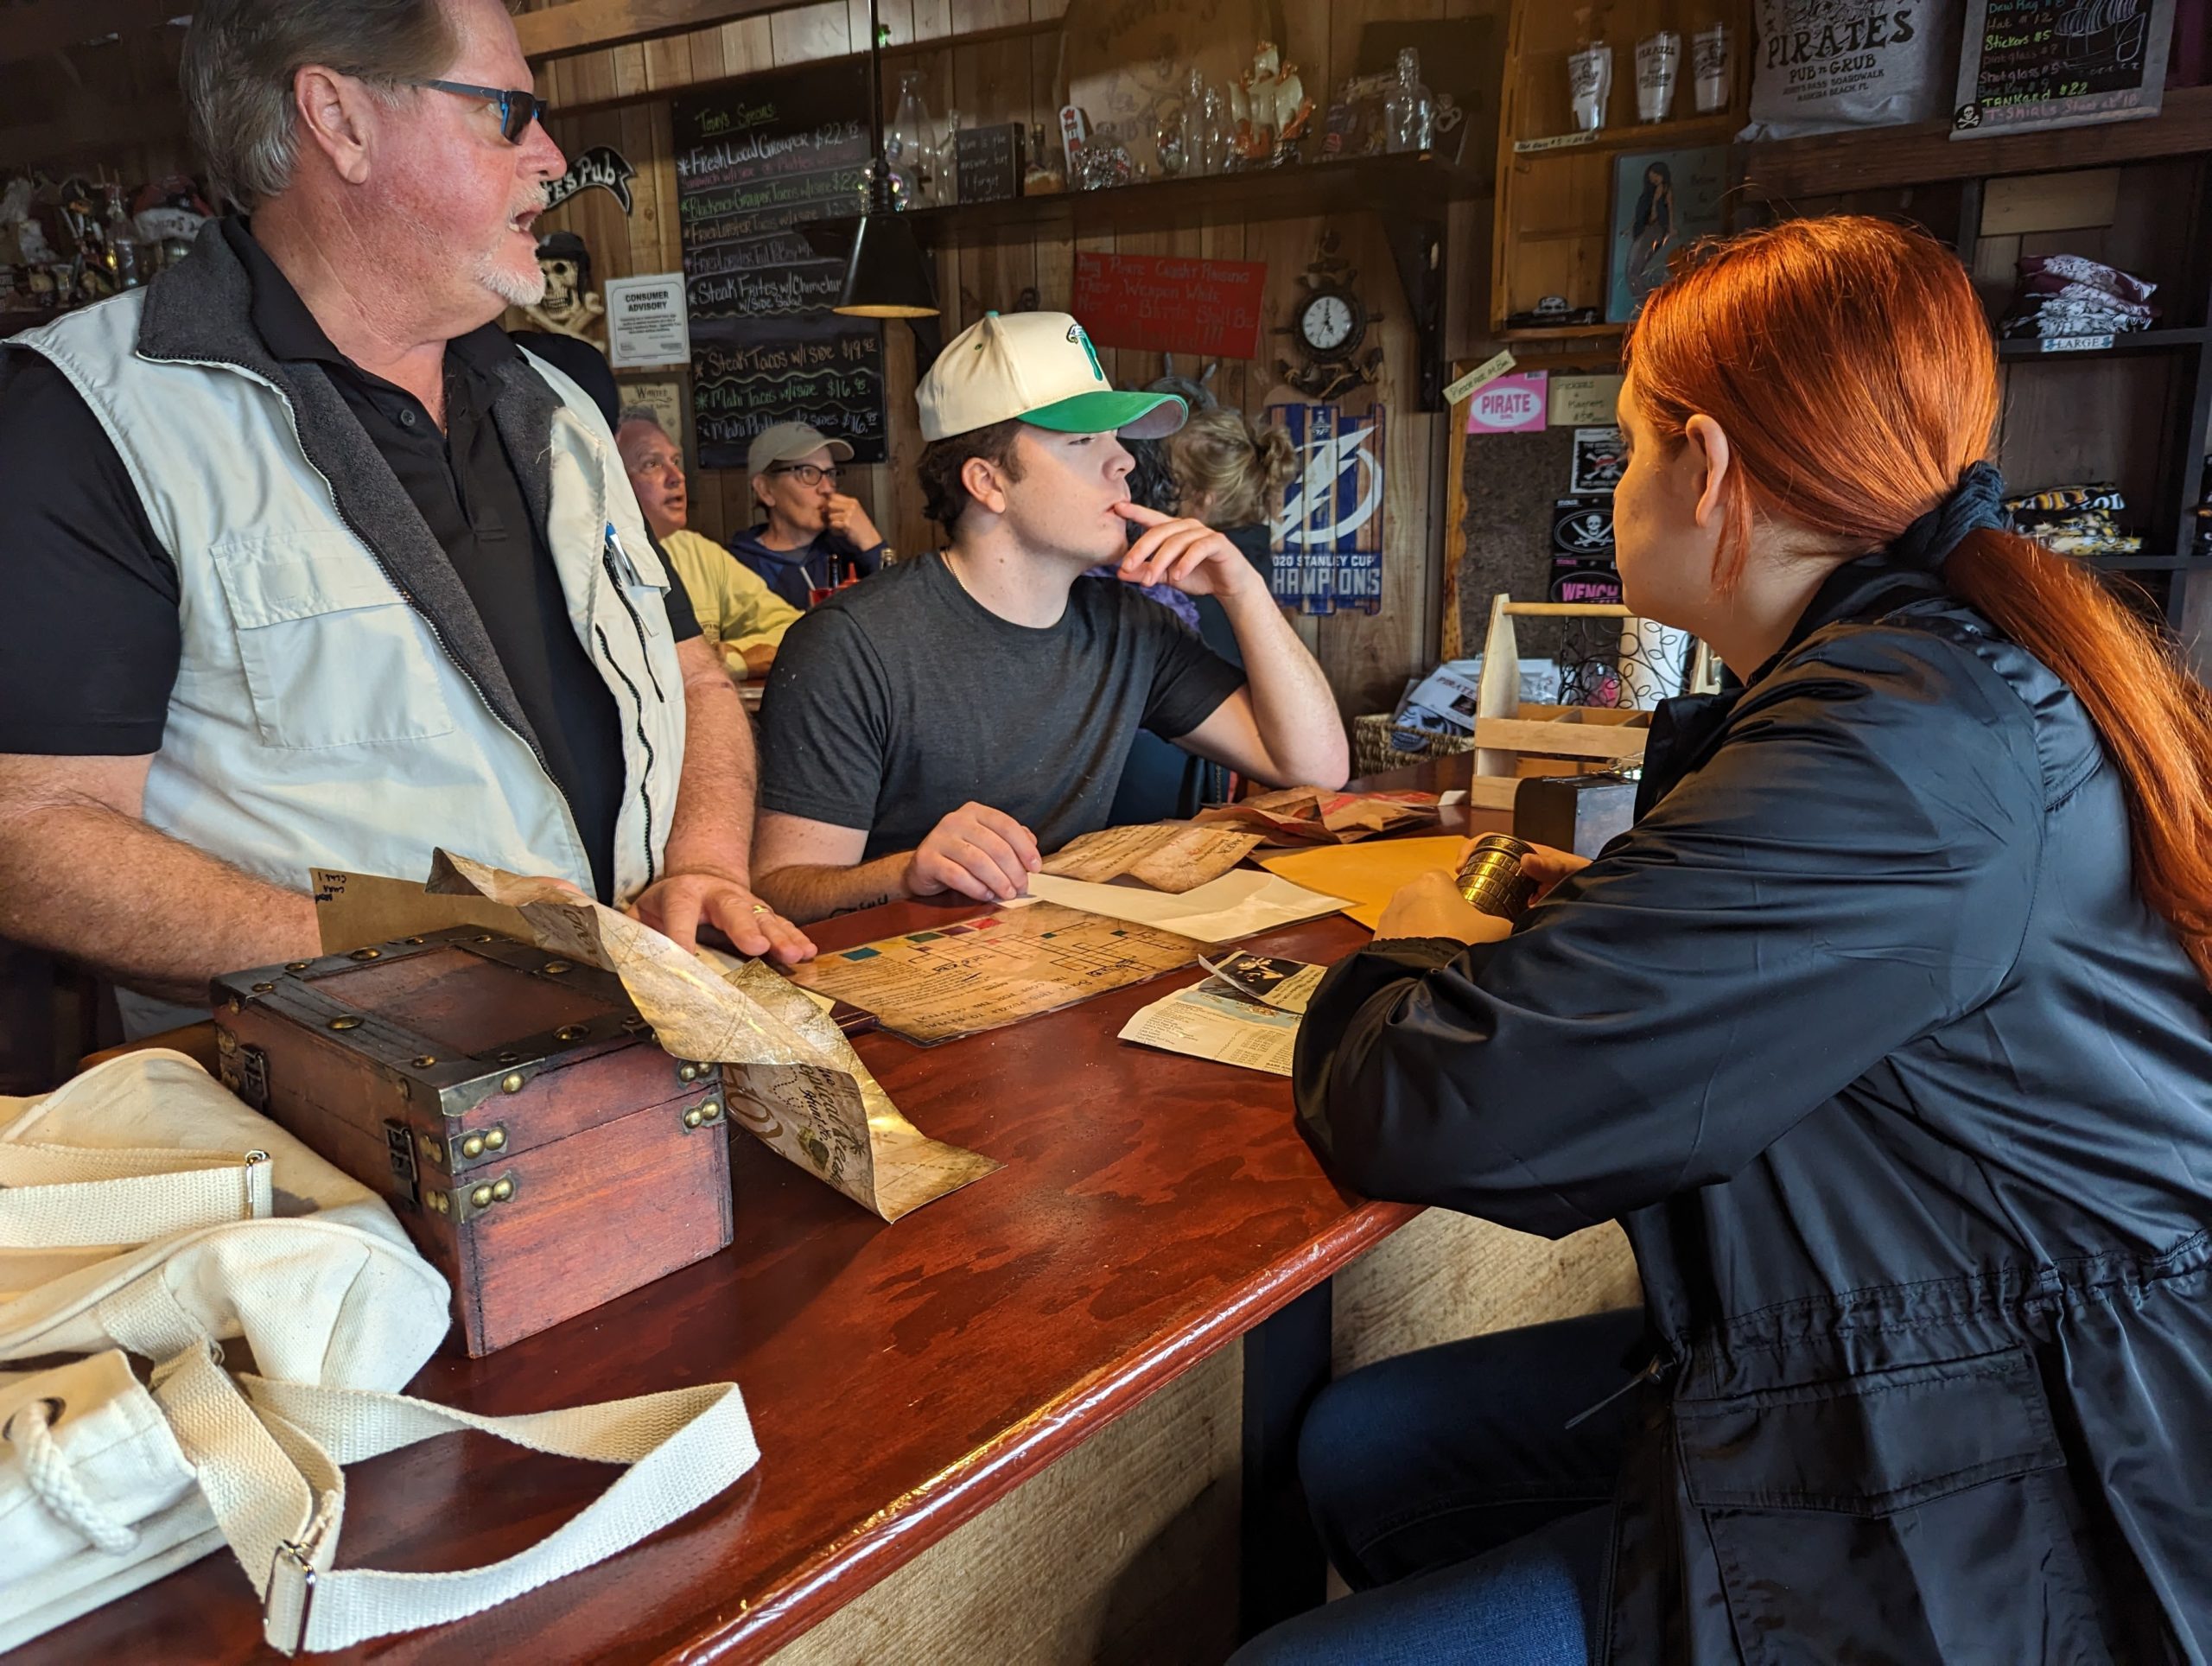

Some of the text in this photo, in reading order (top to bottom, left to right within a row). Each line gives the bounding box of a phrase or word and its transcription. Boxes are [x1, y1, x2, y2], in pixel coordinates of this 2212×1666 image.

[1986, 17, 2012, 30] Hat
[1765, 8, 1916, 70] PIRATES
[1985, 34, 2030, 51] Stickers
[1789, 53, 1877, 84] PUB n GRUB
[1831, 68, 1885, 86] BOARDWALK
[1829, 85, 1857, 98] BEACH
[727, 133, 758, 166] Local
[575, 151, 617, 187] Pub
[626, 291, 669, 303] CONSUMER
[698, 275, 737, 303] Steak
[628, 301, 668, 313] ADVISORY
[2056, 337, 2101, 349] LARGE
[708, 351, 747, 377] Steak
[746, 345, 789, 371] Tacos
[711, 389, 743, 409] Mahi
[741, 385, 777, 408] Tacos
[1482, 393, 1530, 415] PIRATE
[711, 418, 745, 441] Mahi
[1272, 554, 1375, 567] 020 STANLEY CUP
[1271, 568, 1381, 595] HAMPIONS
[997, 992, 1017, 1002] FOR
[991, 1001, 1027, 1014] PUZZLE
